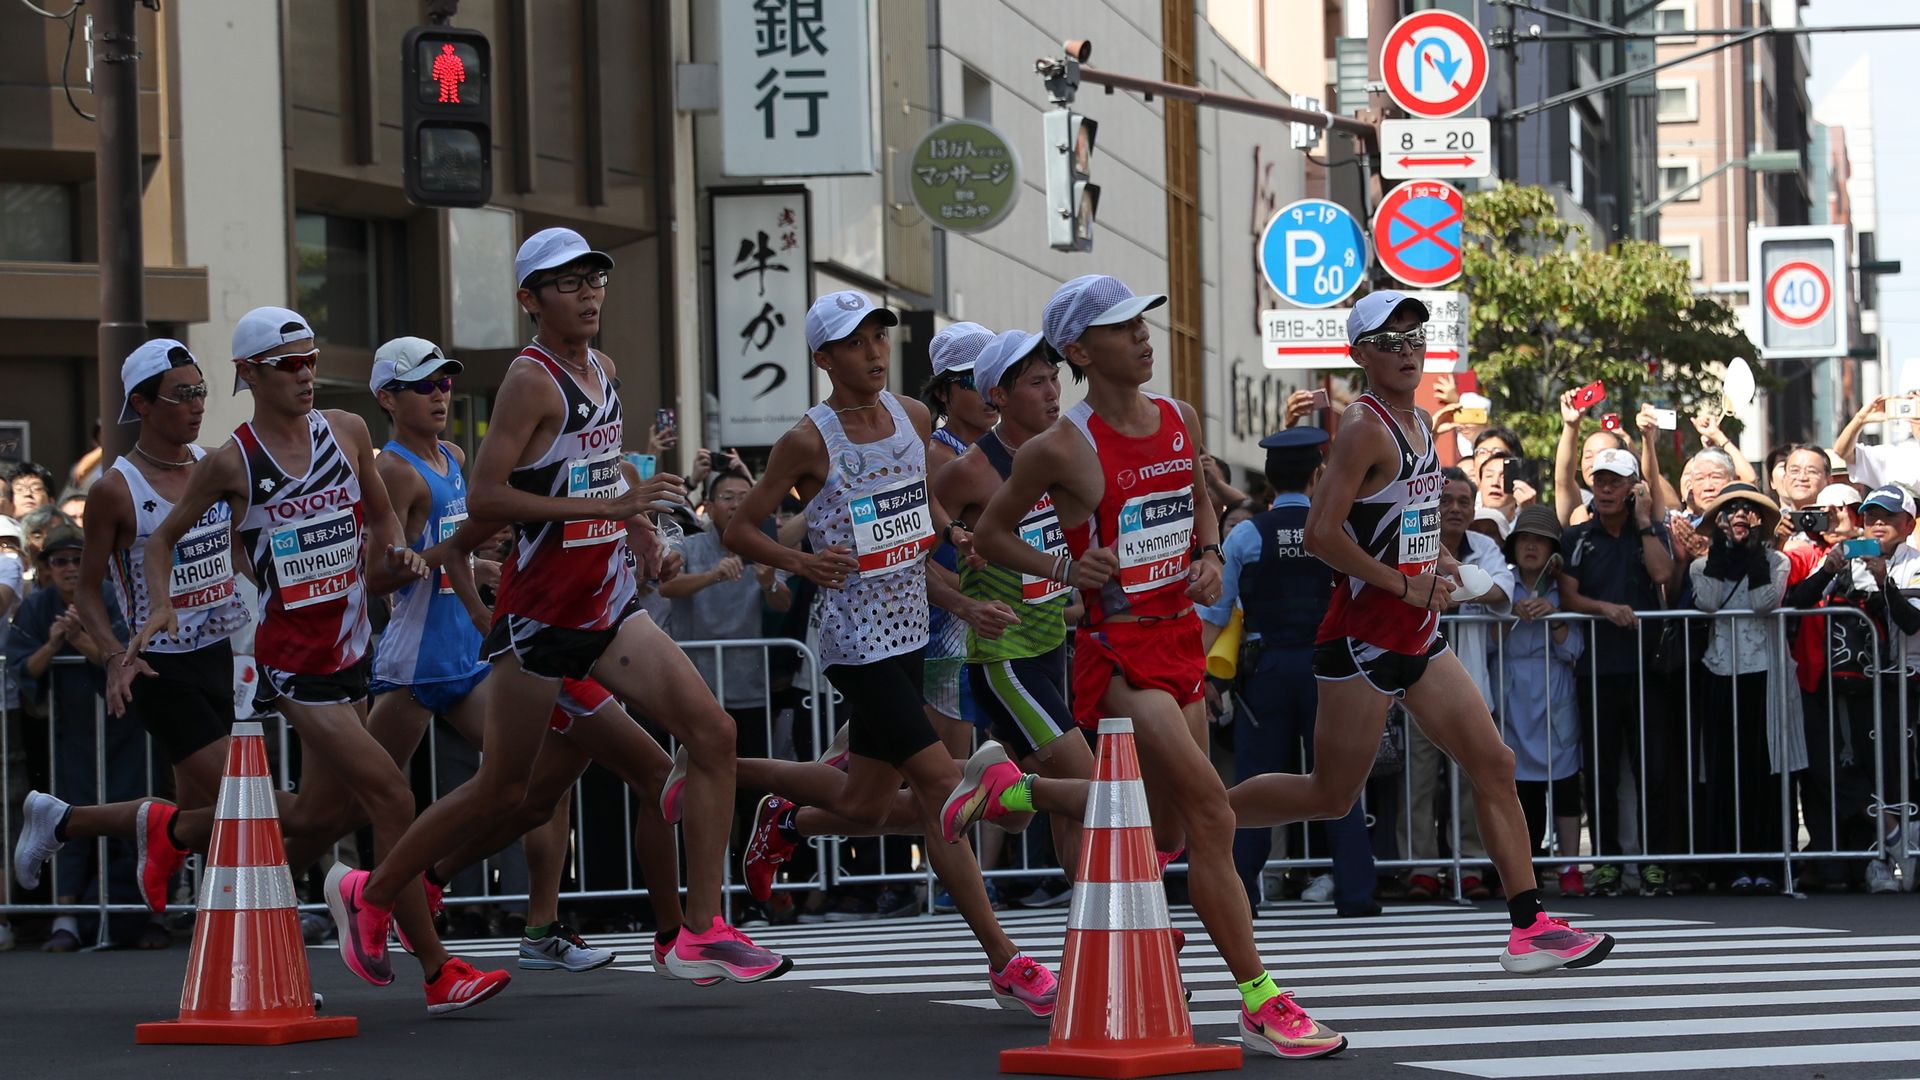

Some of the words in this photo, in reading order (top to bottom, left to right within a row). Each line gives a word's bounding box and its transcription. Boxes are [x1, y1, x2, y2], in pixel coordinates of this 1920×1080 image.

[753, 0, 829, 139] 銀行
[916, 162, 1010, 186] マッサージ
[1291, 205, 1338, 225] 9-19
[1286, 230, 1326, 297] P
[1344, 248, 1356, 268] 分
[1314, 265, 1344, 296] 60
[1782, 279, 1817, 307] 40
[732, 230, 790, 402] 牛かつ
[577, 425, 621, 451] TOYOT
[264, 487, 350, 523] TOYOTA
[878, 487, 924, 512] 東京メトロ
[302, 521, 354, 546] 東京メトロ
[872, 511, 921, 542] OSAKO
[183, 535, 229, 559] 東京メトロ
[1125, 529, 1191, 556] K.YAMAMOT
[173, 555, 227, 587] KAWAI
[283, 544, 355, 577] MIYAWAKI
[309, 574, 348, 598] バイトル
